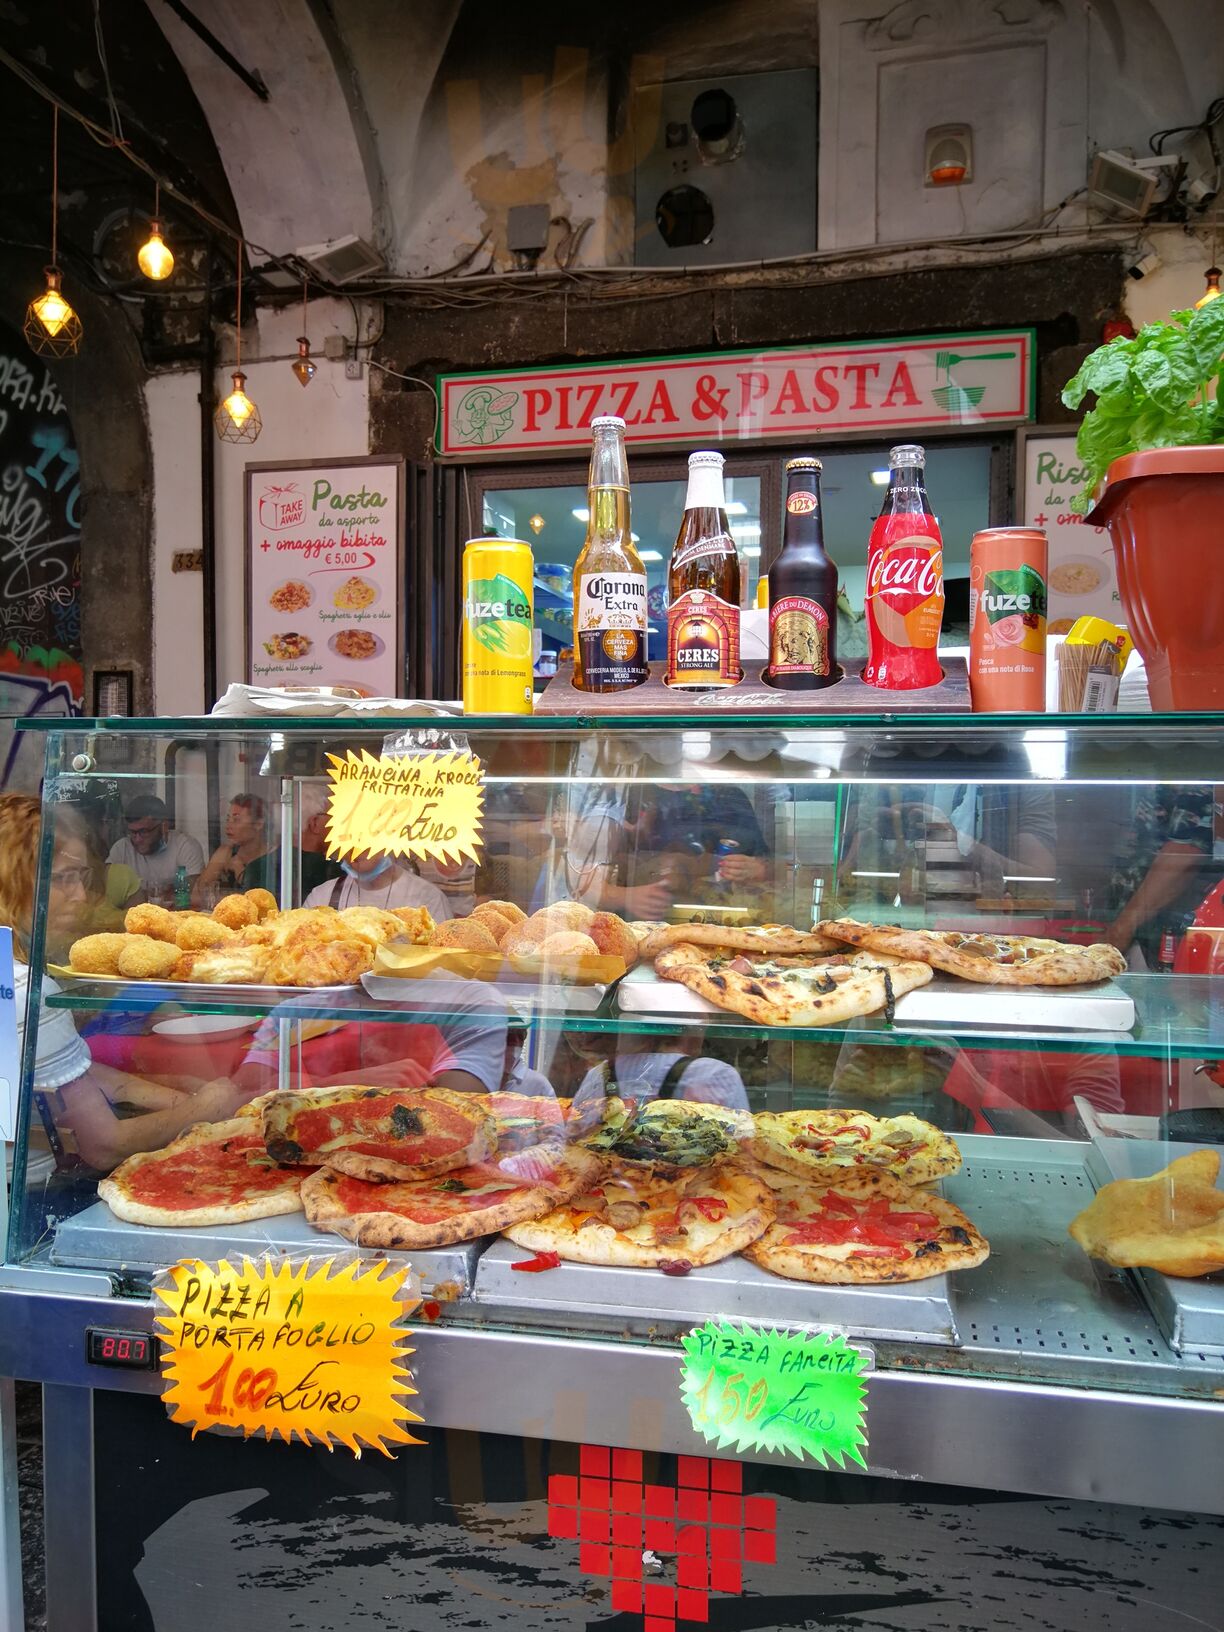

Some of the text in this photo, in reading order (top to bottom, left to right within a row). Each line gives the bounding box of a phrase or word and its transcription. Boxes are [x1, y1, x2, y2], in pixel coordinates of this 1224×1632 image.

[522, 361, 922, 432] PIZZA & PASTA
[312, 479, 388, 511] Pasta
[890, 486, 909, 494] ZERO
[1044, 488, 1065, 506] da
[281, 499, 303, 515] TAKE
[793, 499, 811, 511] 12%
[280, 511, 303, 526] AWAY
[318, 512, 380, 532] da asporto
[276, 536, 336, 559] omaggio
[340, 529, 387, 548] bibita
[325, 553, 332, 564] €
[586, 577, 645, 600] Corona
[605, 596, 638, 611] Extra
[797, 600, 824, 620] DEMON
[318, 610, 352, 623] Spaghetti
[353, 610, 371, 623] aglio
[677, 648, 719, 662] CERES
[253, 664, 284, 676] Spaghetti
[1000, 665, 1014, 673] nota
[180, 1277, 304, 1322] PIZZA A
[101, 1337, 145, 1360] 80.7
[198, 1352, 279, 1418] 1.00
